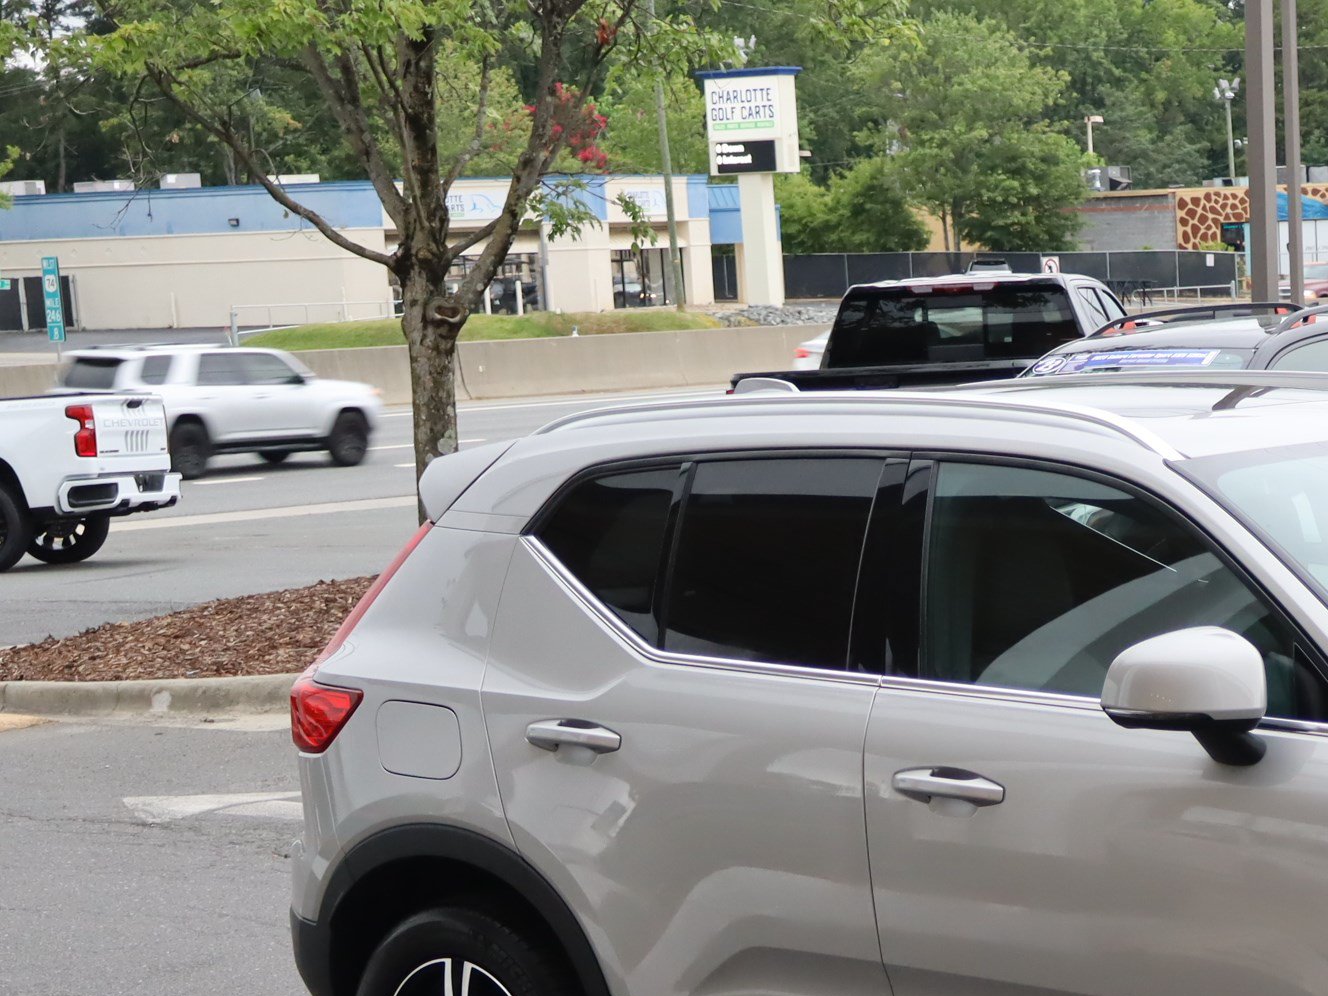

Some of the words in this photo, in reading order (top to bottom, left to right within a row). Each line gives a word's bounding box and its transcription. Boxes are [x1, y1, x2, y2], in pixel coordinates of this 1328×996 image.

[711, 88, 772, 105] CHARLOTTE
[711, 106, 736, 121] GOLF
[740, 104, 774, 120] CARTS
[46, 278, 55, 288] 74
[103, 417, 163, 428] CHEVROLET
